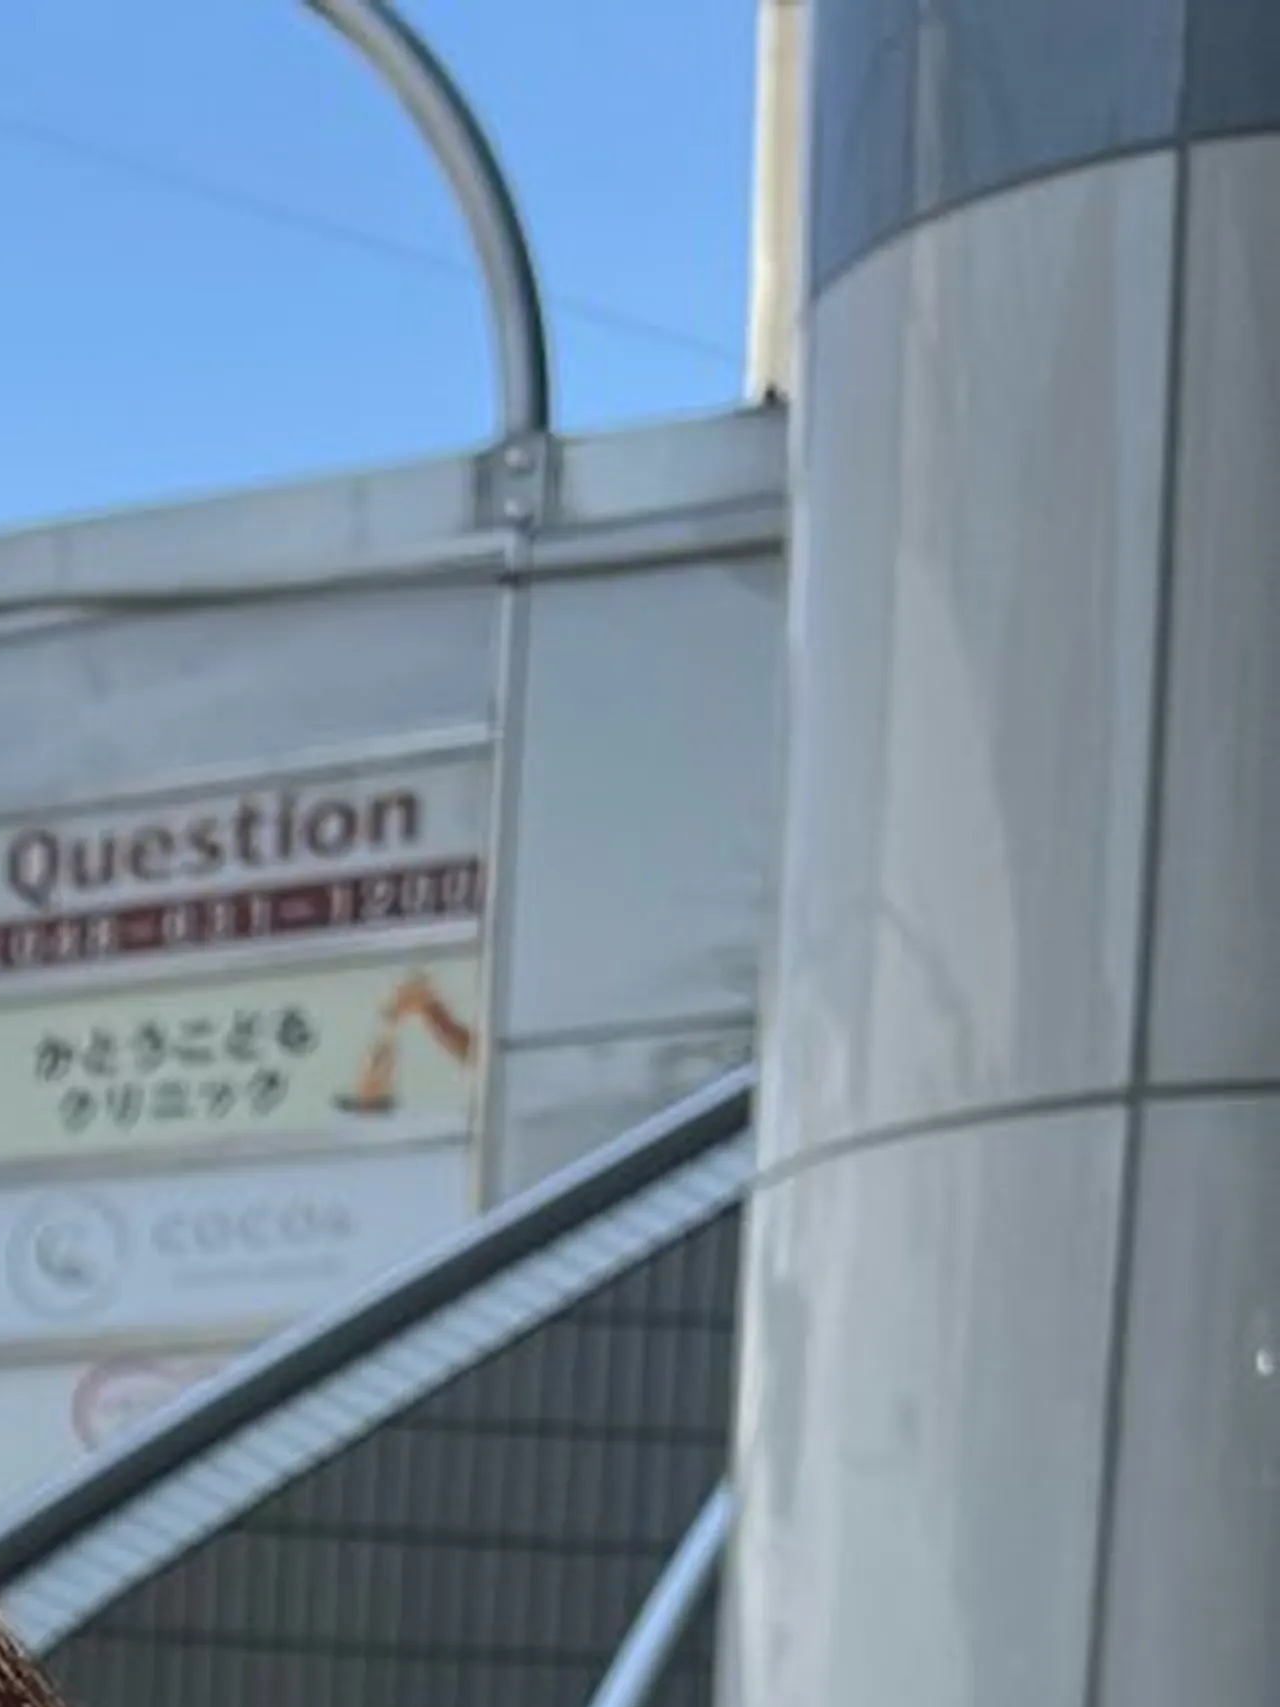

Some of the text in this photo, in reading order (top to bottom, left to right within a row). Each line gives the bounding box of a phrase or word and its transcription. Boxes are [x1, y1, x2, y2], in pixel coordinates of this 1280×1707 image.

[7, 789, 419, 905] Question
[35, 1004, 320, 1083] かとうこども
[58, 1067, 290, 1133] クリニック
